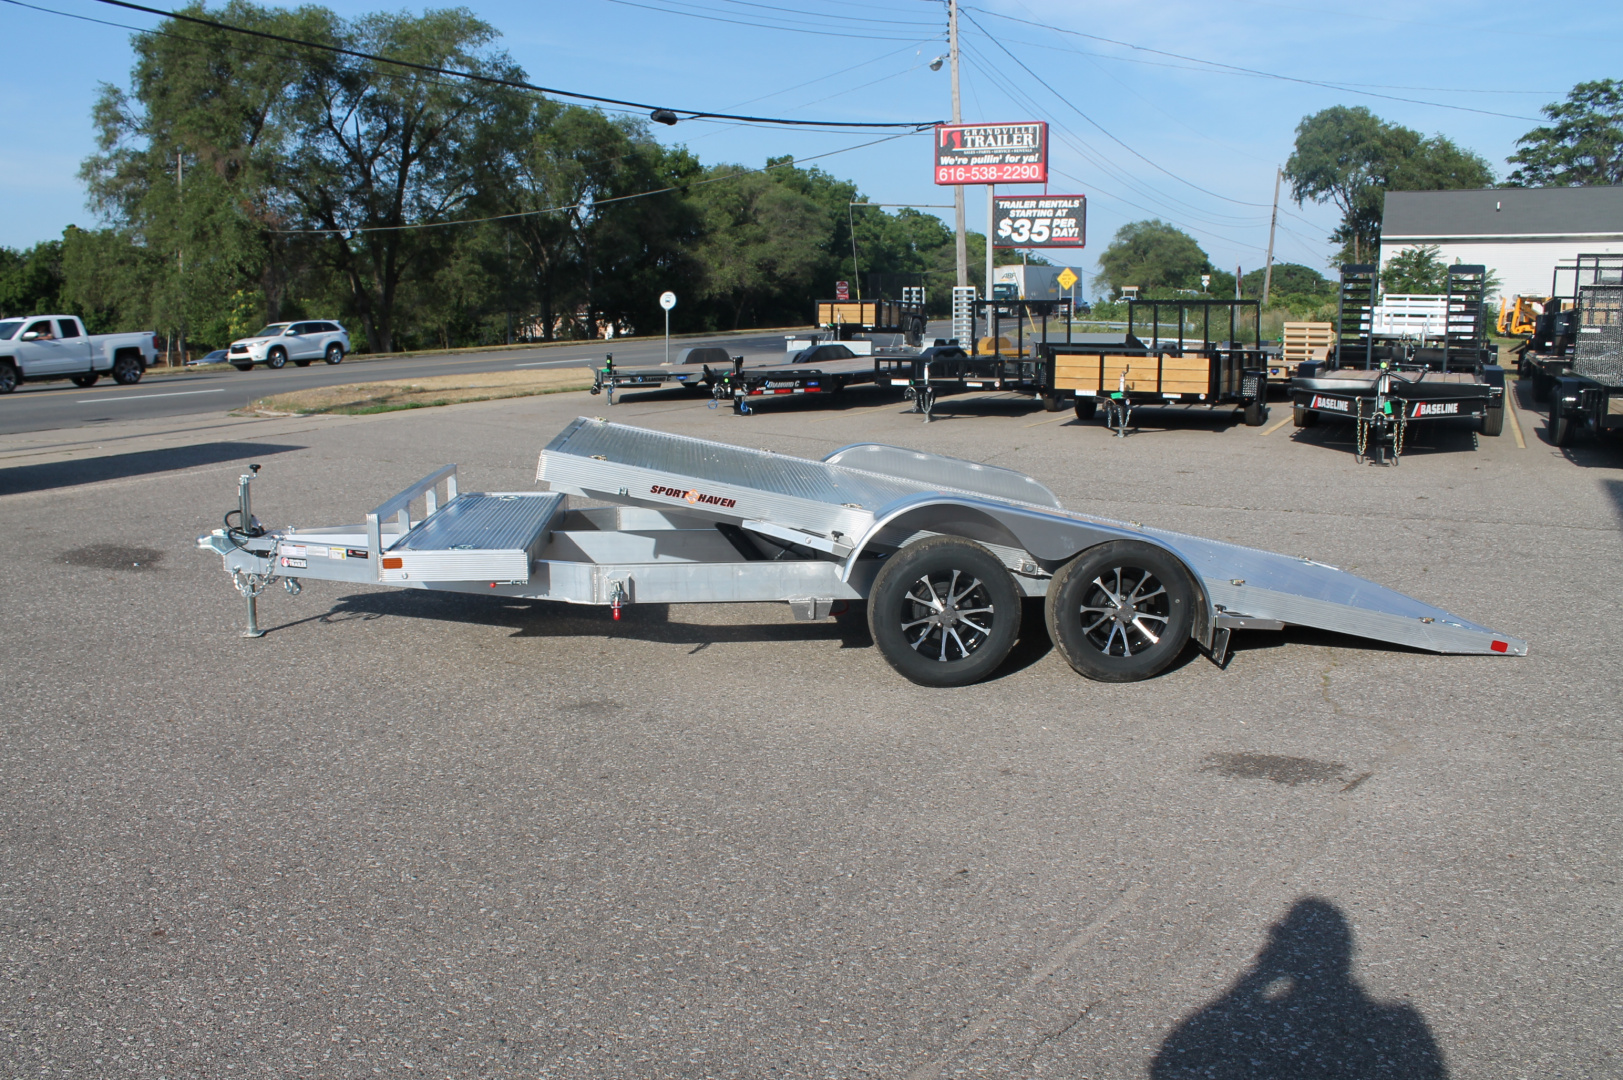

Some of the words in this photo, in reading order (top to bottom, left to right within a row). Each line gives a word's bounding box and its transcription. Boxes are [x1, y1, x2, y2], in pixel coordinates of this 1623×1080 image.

[964, 127, 1034, 136] GRANDVILLE
[964, 134, 1033, 147] TRAILER
[940, 156, 968, 165] We're
[970, 154, 1002, 165] pullin'
[1005, 154, 1020, 163] for
[1022, 153, 1039, 164] ya!
[939, 165, 1039, 181] 616-538-2290
[999, 200, 1036, 208] TRAILER
[1038, 200, 1080, 208] RENTALS
[1009, 209, 1053, 217] STARTING
[1055, 209, 1068, 217] AT
[998, 217, 1051, 243] $35
[1052, 218, 1076, 228] PER
[1052, 227, 1079, 237] DAY!
[1317, 397, 1349, 412] BASELINE
[1420, 403, 1459, 415] BASELINE
[650, 485, 689, 499] SPORT
[697, 493, 736, 508] HAVEN
